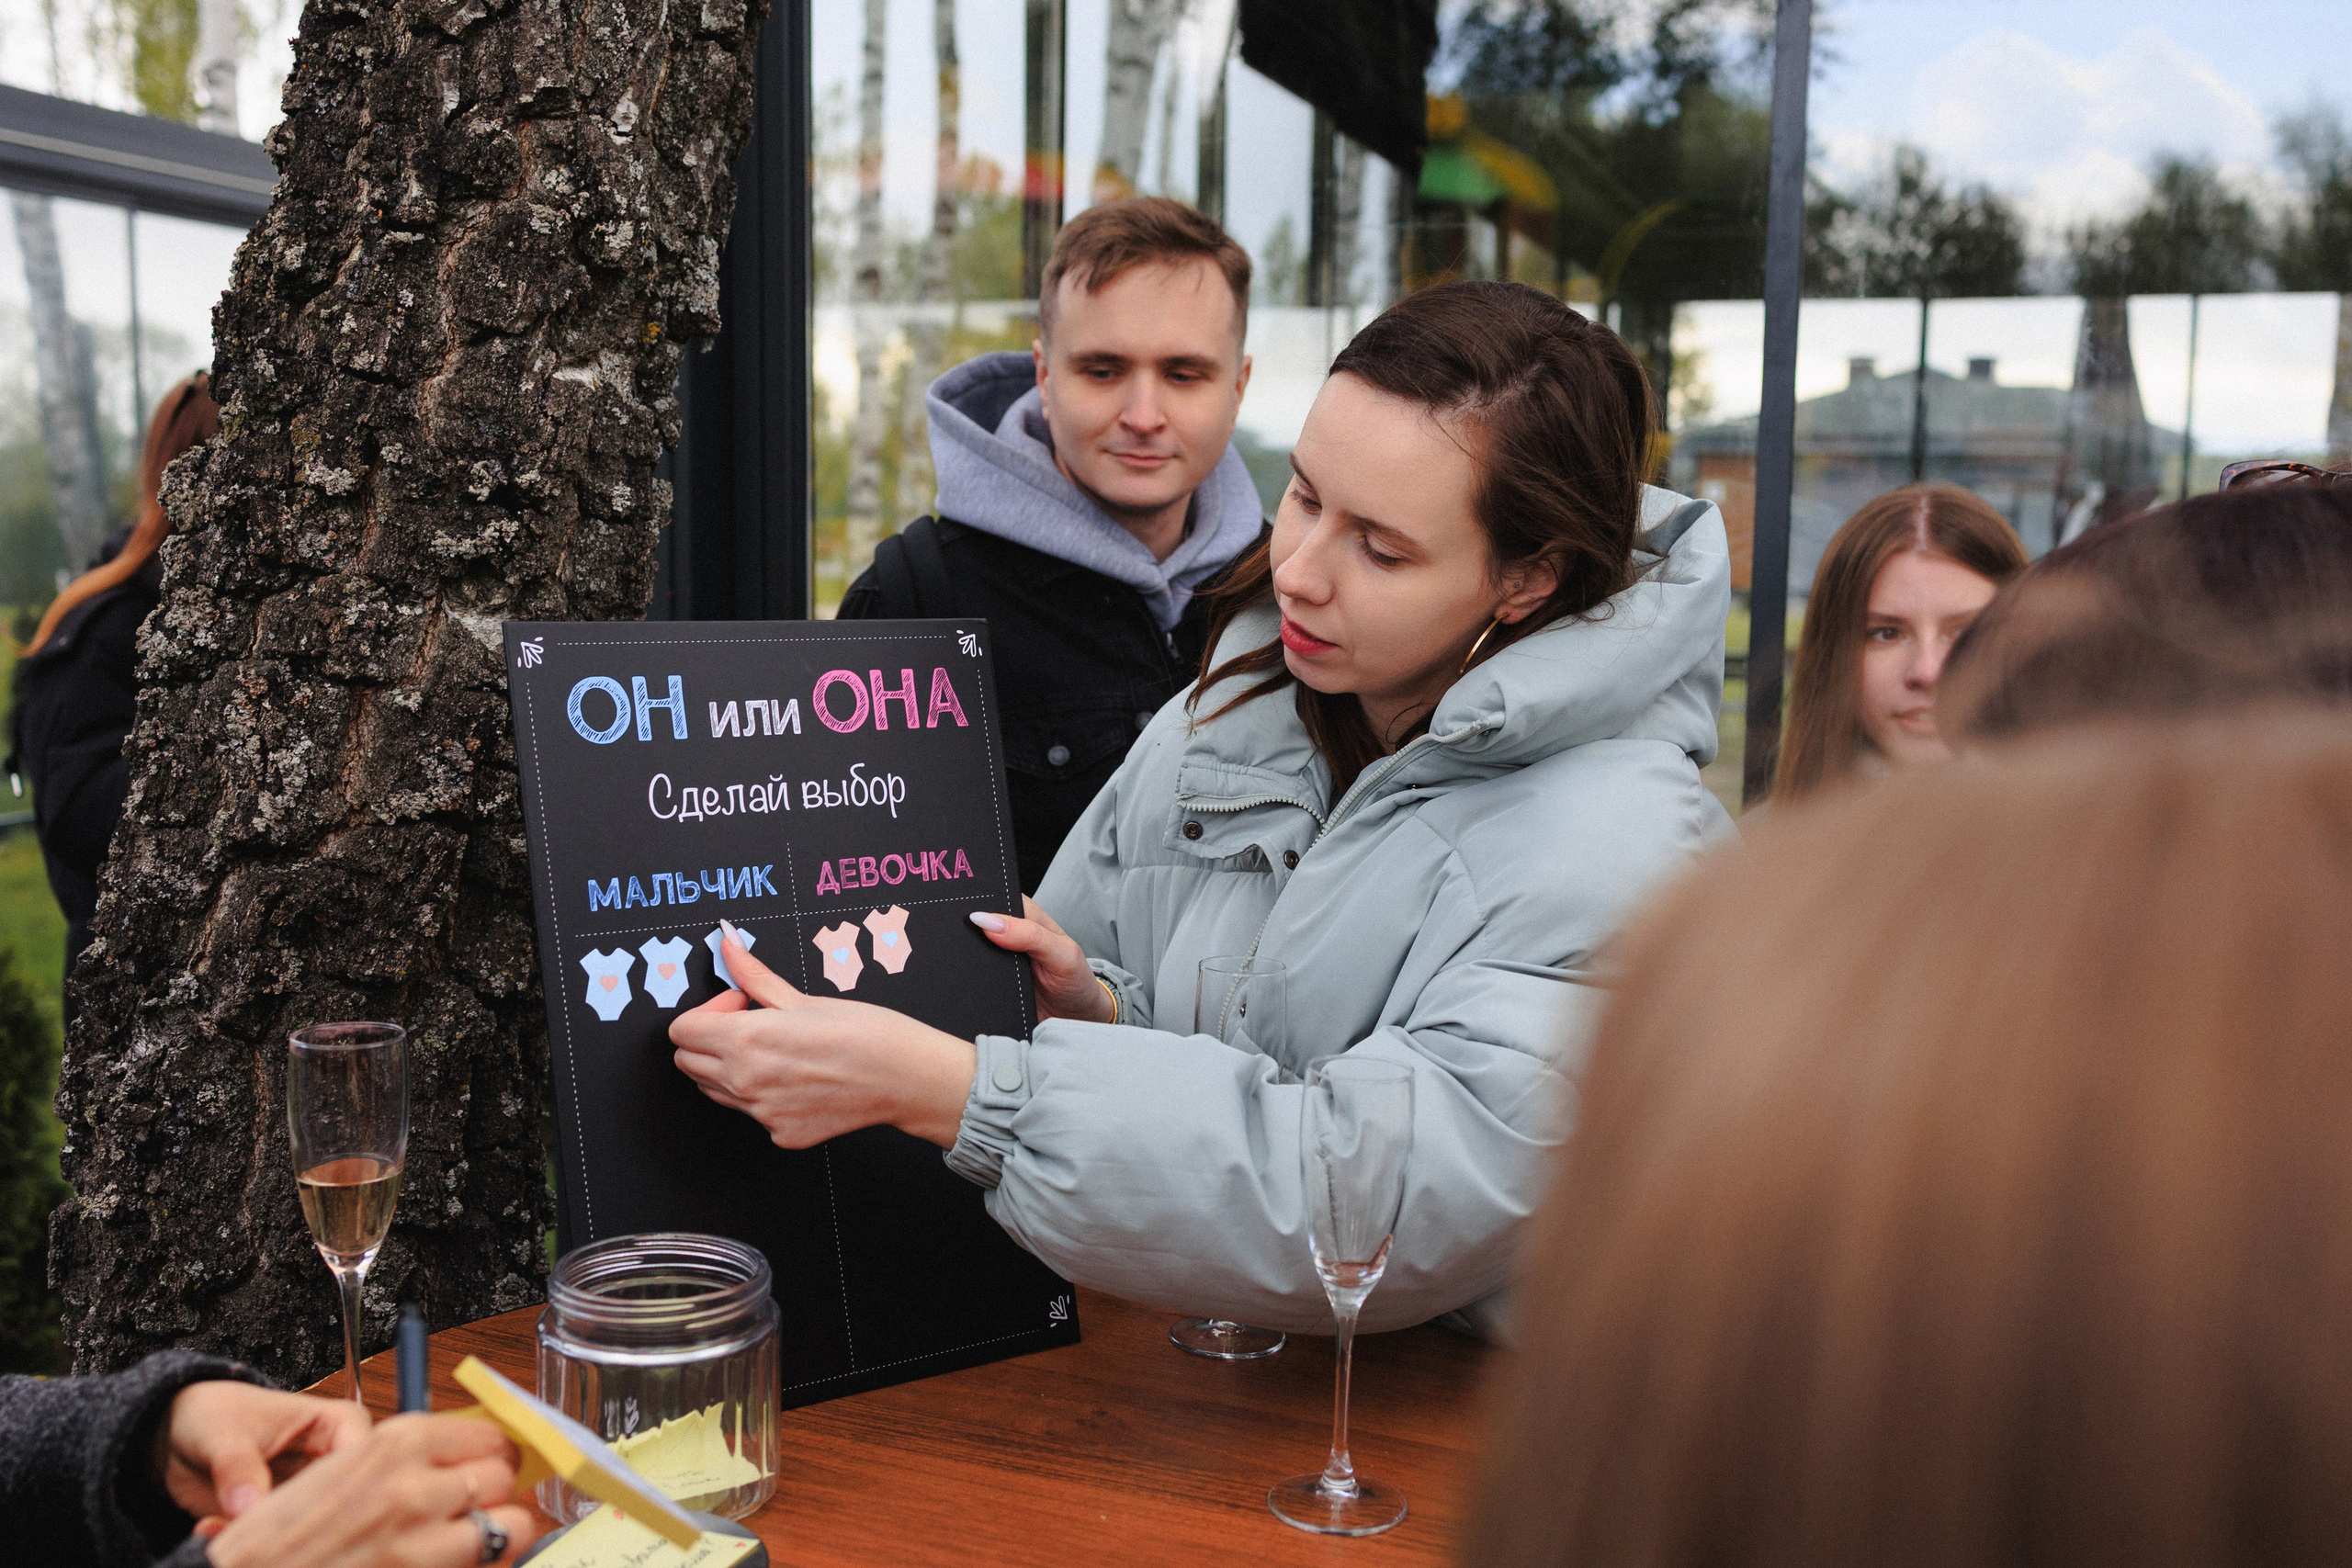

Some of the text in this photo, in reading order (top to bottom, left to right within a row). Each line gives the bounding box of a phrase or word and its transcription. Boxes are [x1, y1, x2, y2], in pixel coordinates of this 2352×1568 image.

[566, 675, 688, 744] ОН
[812, 667, 968, 733] ОНА
[649, 762, 905, 823] Сделай выбор
[588, 864, 778, 912] МАЛЬЧИК
[816, 849, 974, 896] ДЕВОЧКА
